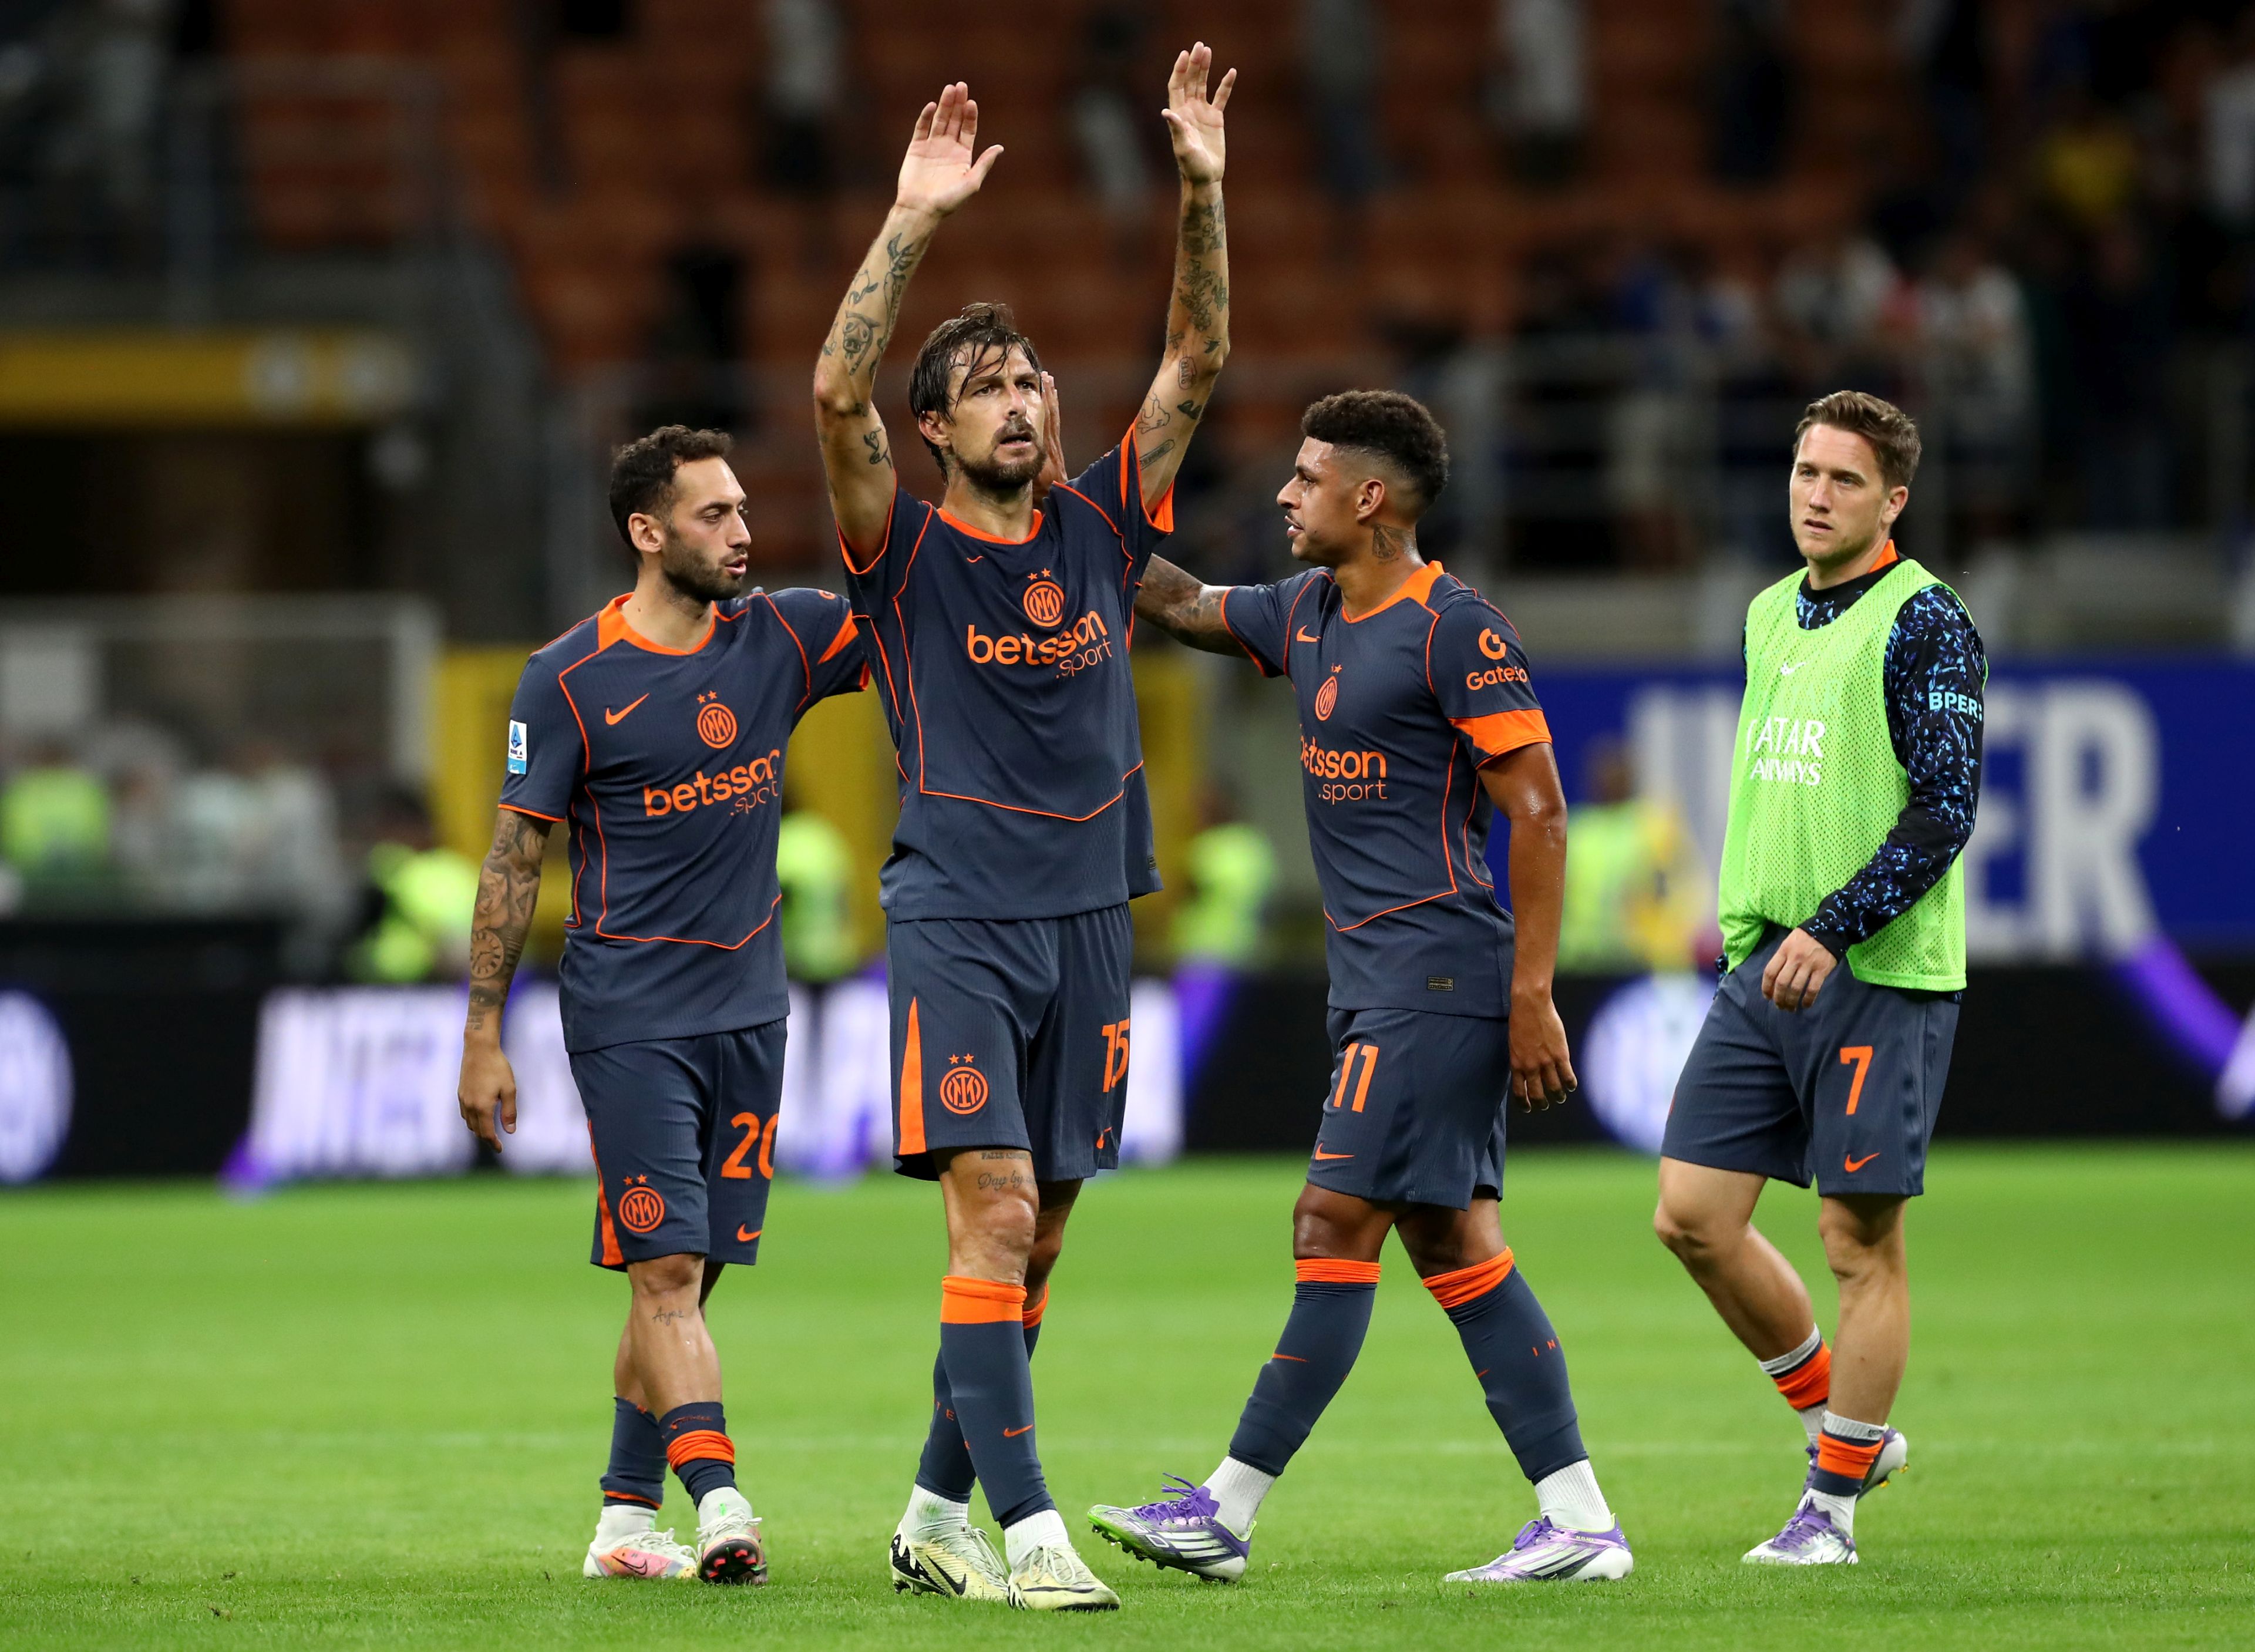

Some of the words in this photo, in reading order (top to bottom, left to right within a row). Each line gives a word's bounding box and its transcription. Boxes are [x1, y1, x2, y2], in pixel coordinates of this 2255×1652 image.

[968, 611, 1108, 665] betsson
[1102, 1018, 1130, 1093] 15
[1333, 1043, 1379, 1112] 11
[1840, 1045, 1873, 1115] 7
